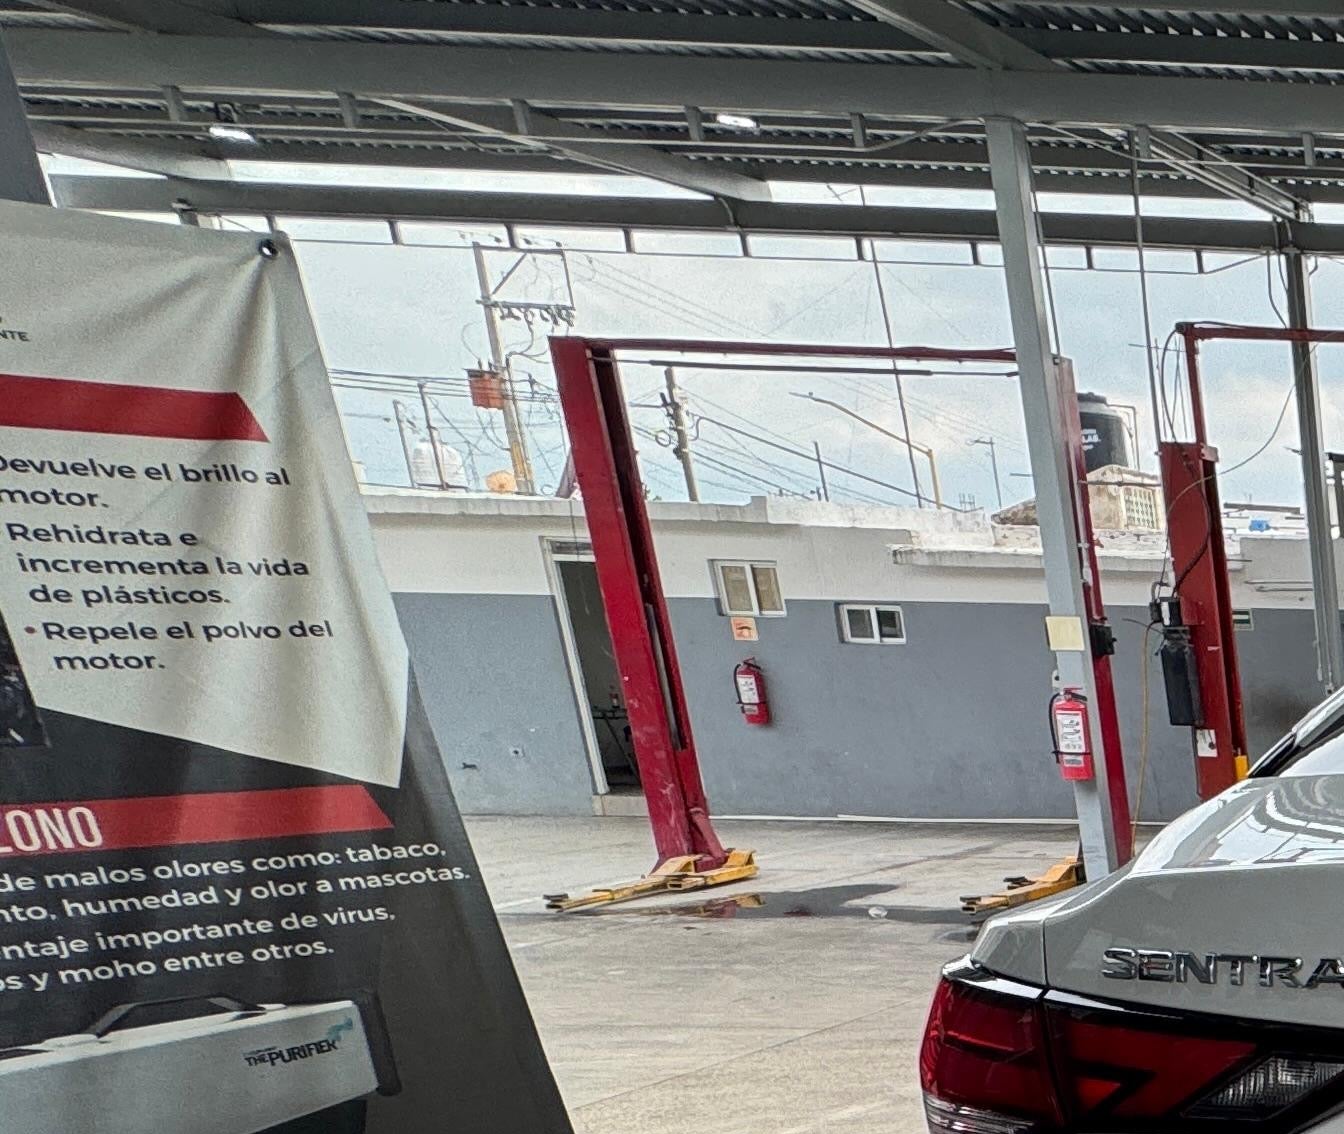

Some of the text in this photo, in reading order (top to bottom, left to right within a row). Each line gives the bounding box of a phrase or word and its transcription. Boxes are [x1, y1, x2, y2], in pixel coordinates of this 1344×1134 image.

[145, 463, 172, 482] el
[180, 463, 259, 485] brillo
[265, 467, 291, 486] al
[0, 487, 109, 508] motor.
[6, 522, 198, 546] Rehidrata e
[17, 553, 309, 576] incrementa la vida
[29, 584, 231, 607] de plásticos.
[42, 620, 334, 644] Repele el polvo del
[54, 653, 166, 670] motor.
[44, 866, 147, 889] malos
[153, 859, 246, 880] olores
[252, 852, 342, 872] como:
[345, 843, 447, 863] tabaco,
[62, 886, 220, 918] humedad
[224, 888, 242, 906] y
[251, 880, 308, 900] olor
[315, 880, 333, 893] a
[338, 866, 471, 891] mascotas.
[95, 918, 273, 950] importante
[280, 913, 318, 931] de
[323, 906, 396, 926] virus,
[28, 972, 48, 991] y
[58, 959, 157, 984] moho
[164, 950, 245, 972] entre
[251, 941, 335, 962] otros.
